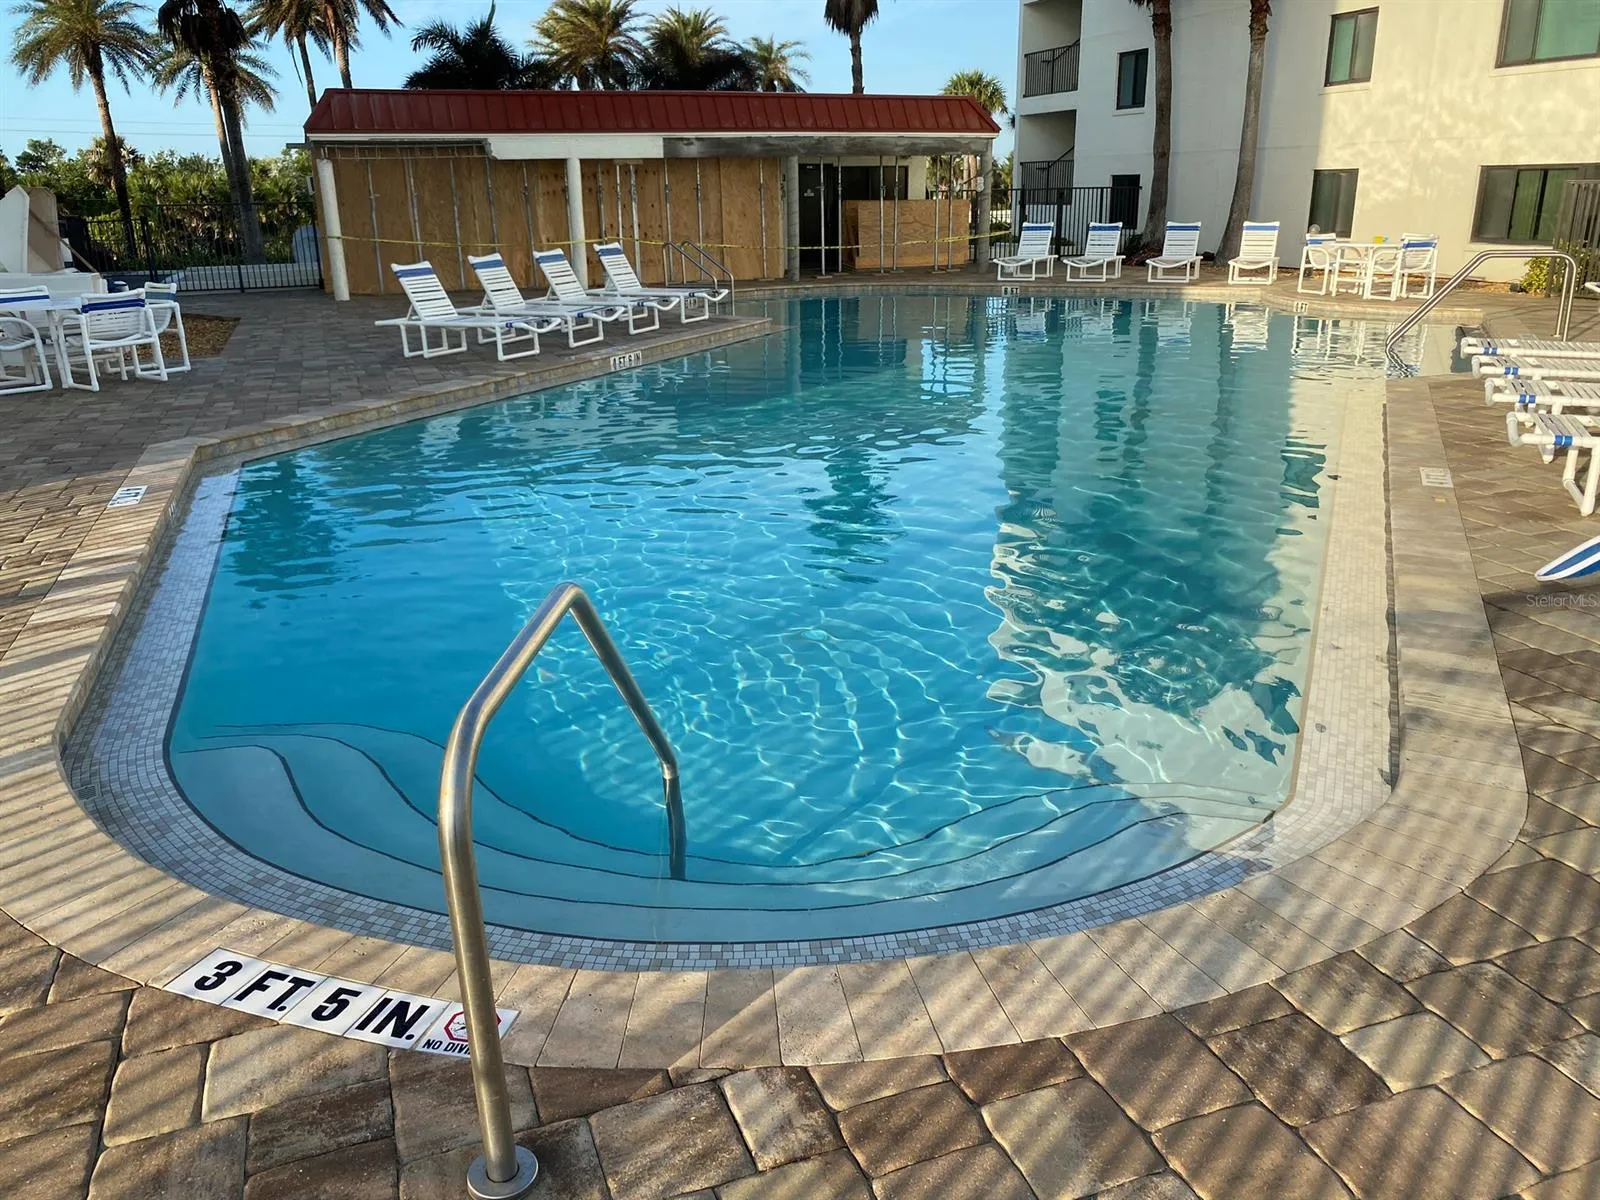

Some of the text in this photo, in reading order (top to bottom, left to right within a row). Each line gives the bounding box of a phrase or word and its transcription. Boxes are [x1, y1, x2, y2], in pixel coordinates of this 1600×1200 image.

[194, 960, 431, 1041] 3 FT. 5 IN.
[421, 1038, 471, 1055] NO DIVI
